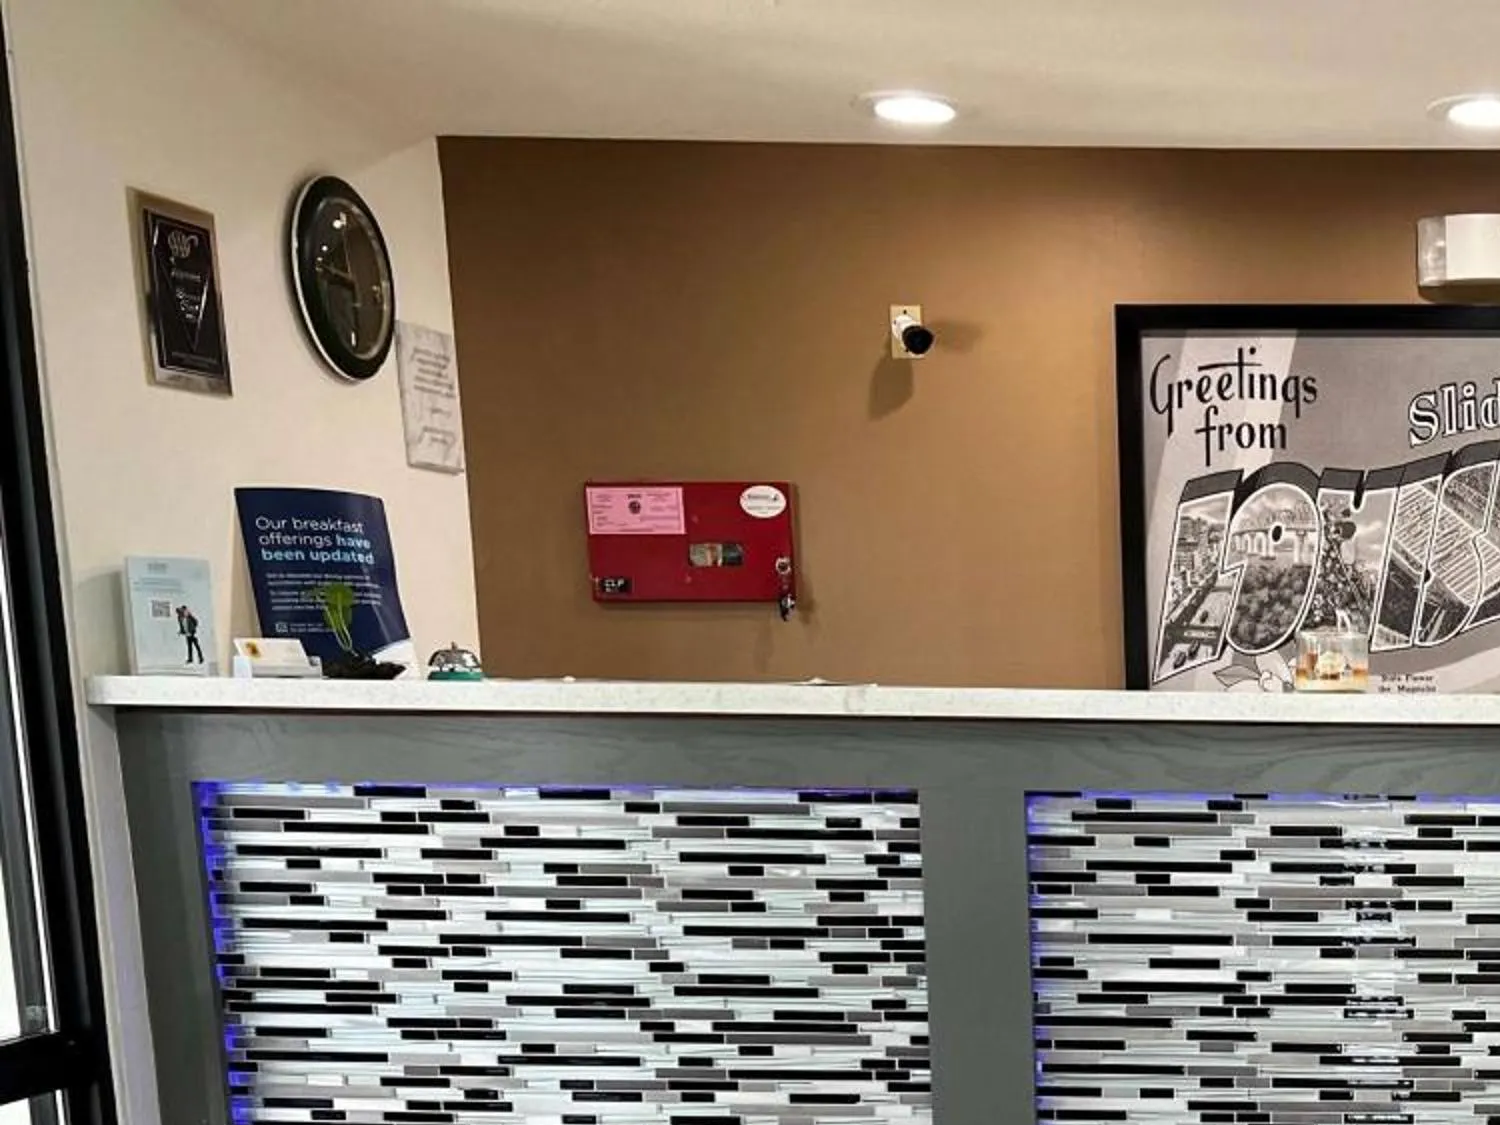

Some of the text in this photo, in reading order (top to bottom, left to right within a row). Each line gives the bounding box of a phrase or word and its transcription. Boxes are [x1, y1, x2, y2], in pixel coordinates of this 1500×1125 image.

[1150, 347, 1318, 439] Greetings
[1195, 405, 1287, 467] from
[255, 516, 364, 534] Our breakfast
[258, 531, 371, 549] offerings have
[261, 548, 375, 565] been updated
